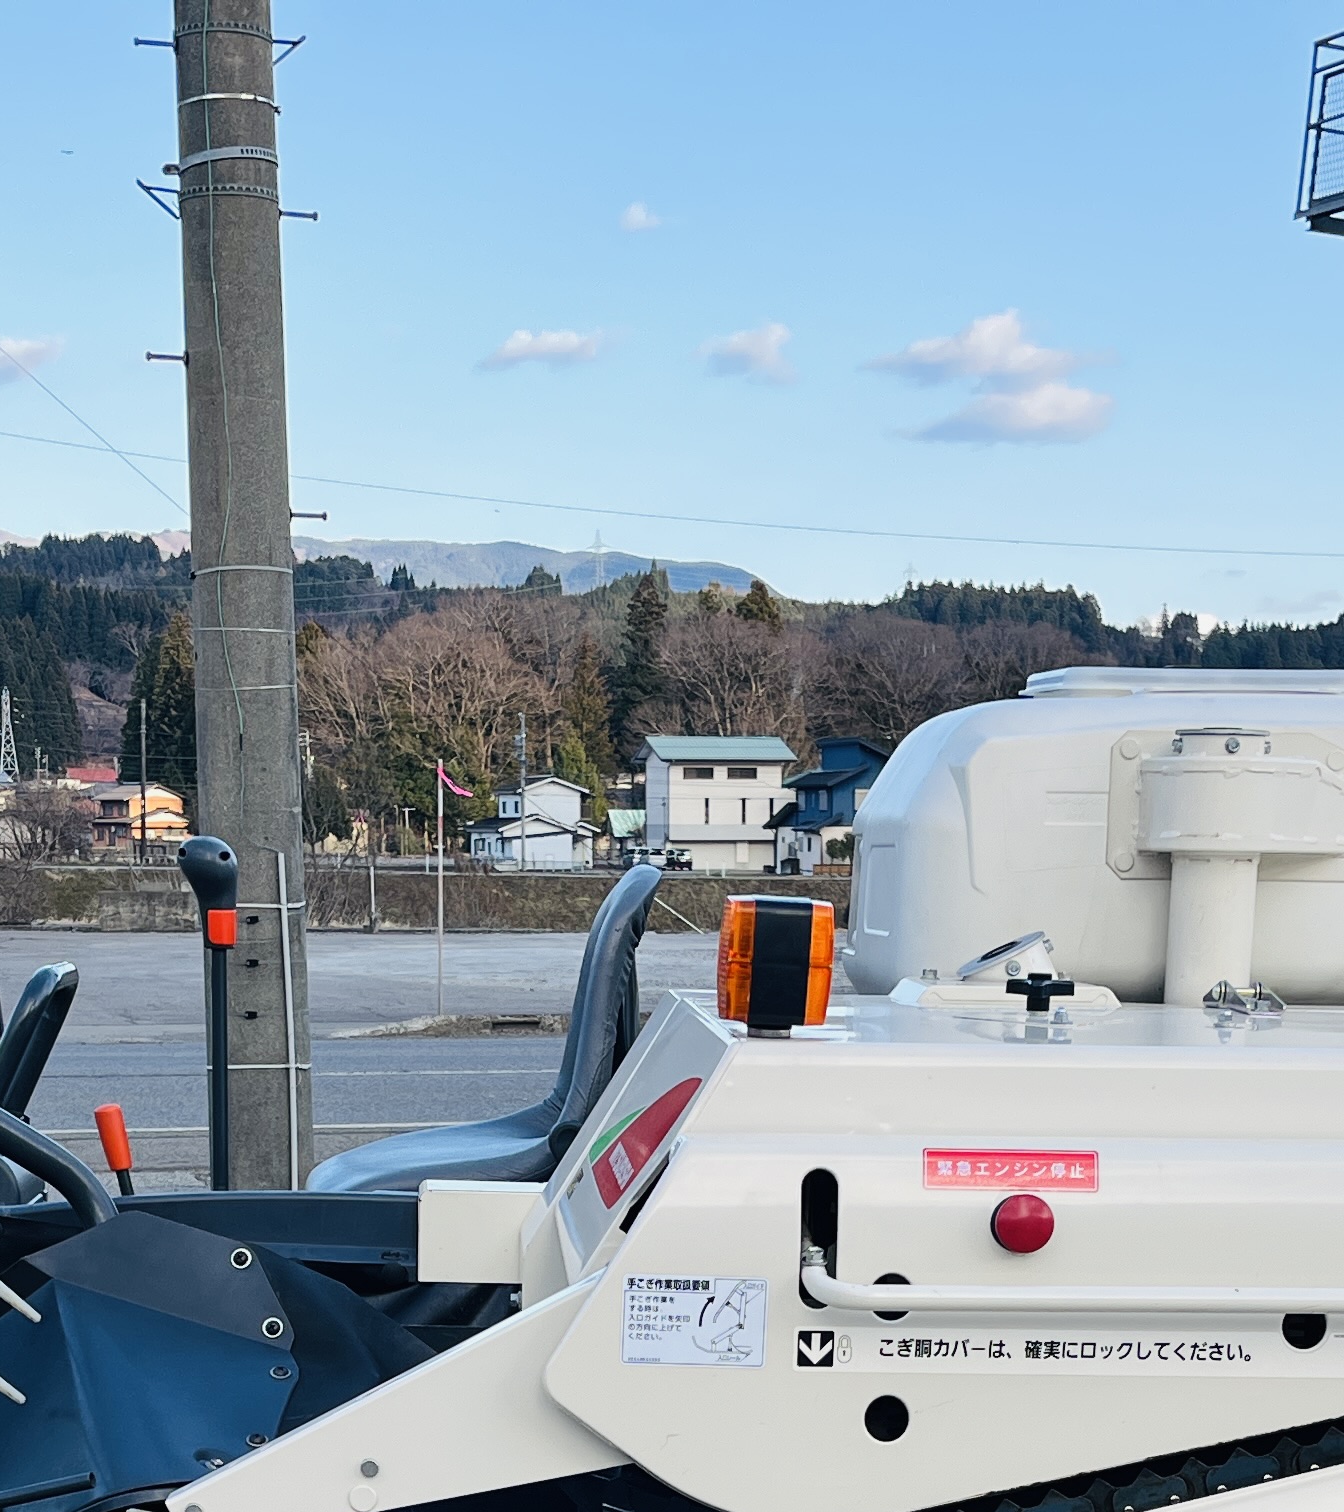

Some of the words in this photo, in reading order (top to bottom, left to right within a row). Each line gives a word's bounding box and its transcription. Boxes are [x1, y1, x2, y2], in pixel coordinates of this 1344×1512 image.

[937, 1160, 1085, 1179] 緊急エンジン停止
[629, 1295, 675, 1304] 手こぎ作業を
[879, 1338, 1253, 1362] こぎ胴カバーは、確実にロックしてください。
